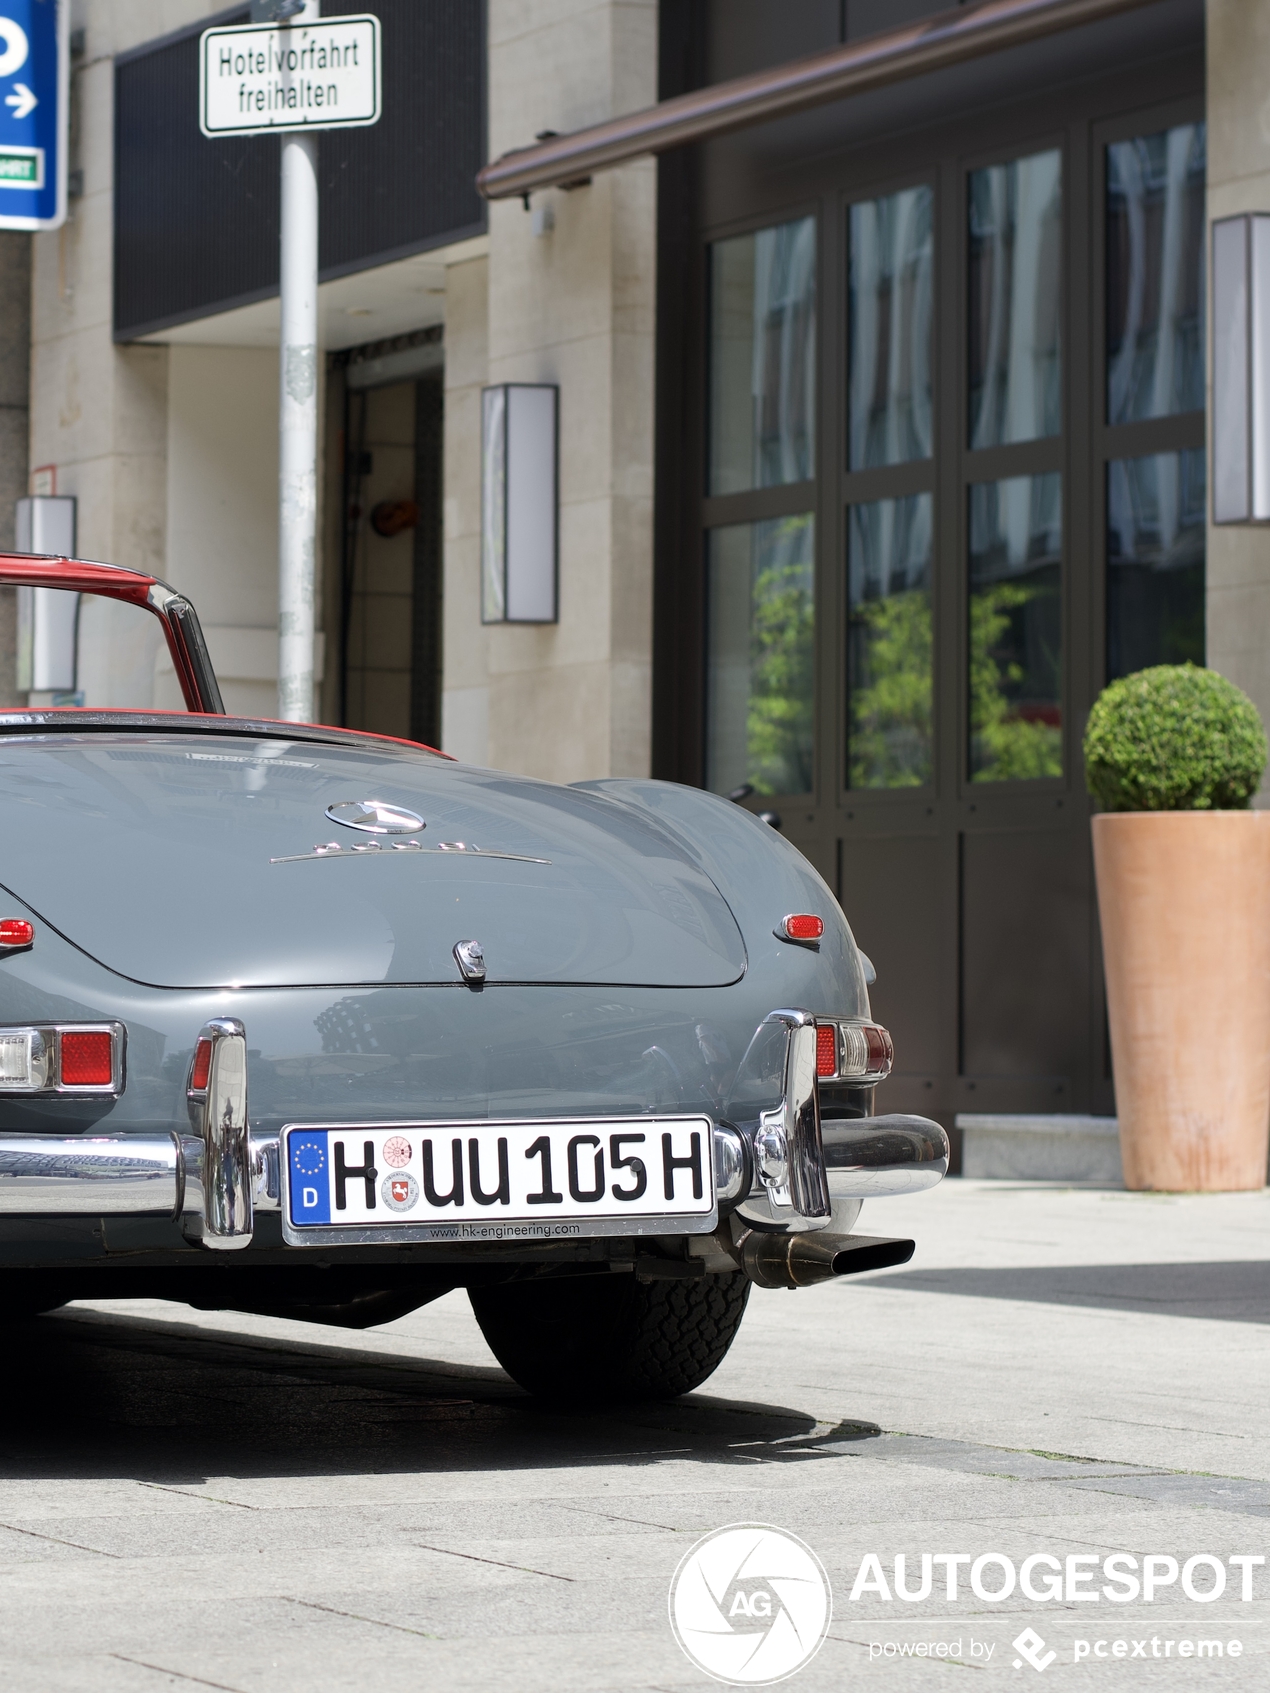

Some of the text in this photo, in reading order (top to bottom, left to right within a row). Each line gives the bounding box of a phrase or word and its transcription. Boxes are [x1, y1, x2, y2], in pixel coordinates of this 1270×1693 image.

[219, 39, 359, 77] Hotelvorfahrt
[239, 78, 338, 112] freihalten
[334, 1141, 377, 1210] H
[303, 1187, 318, 1208] D
[430, 1222, 580, 1239] www.hk-engineering.com
